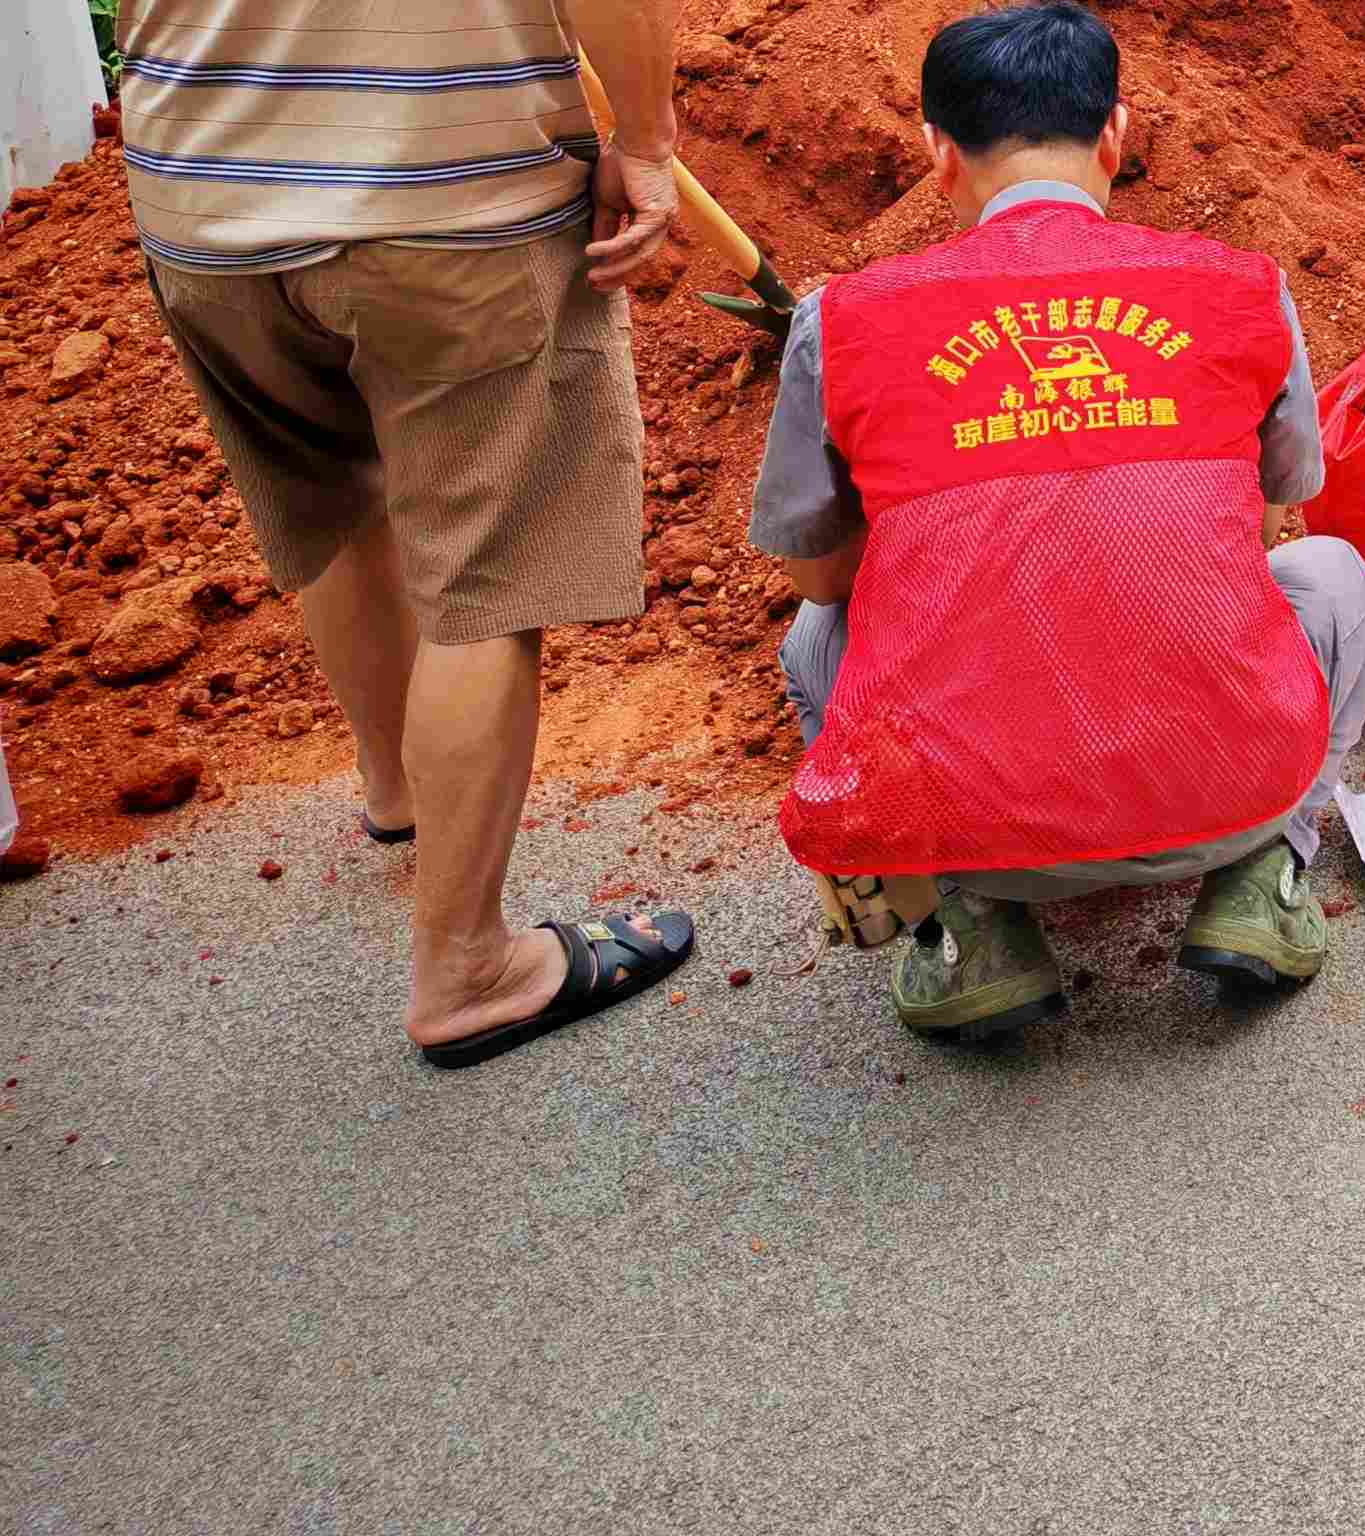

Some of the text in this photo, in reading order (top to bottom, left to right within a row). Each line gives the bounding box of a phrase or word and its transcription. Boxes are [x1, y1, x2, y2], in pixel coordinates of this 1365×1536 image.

[925, 296, 1194, 386] 海口市老干部志愿服务者
[999, 372, 1131, 410] 南海银辉
[951, 397, 1180, 450] 琼崖初心正能量
